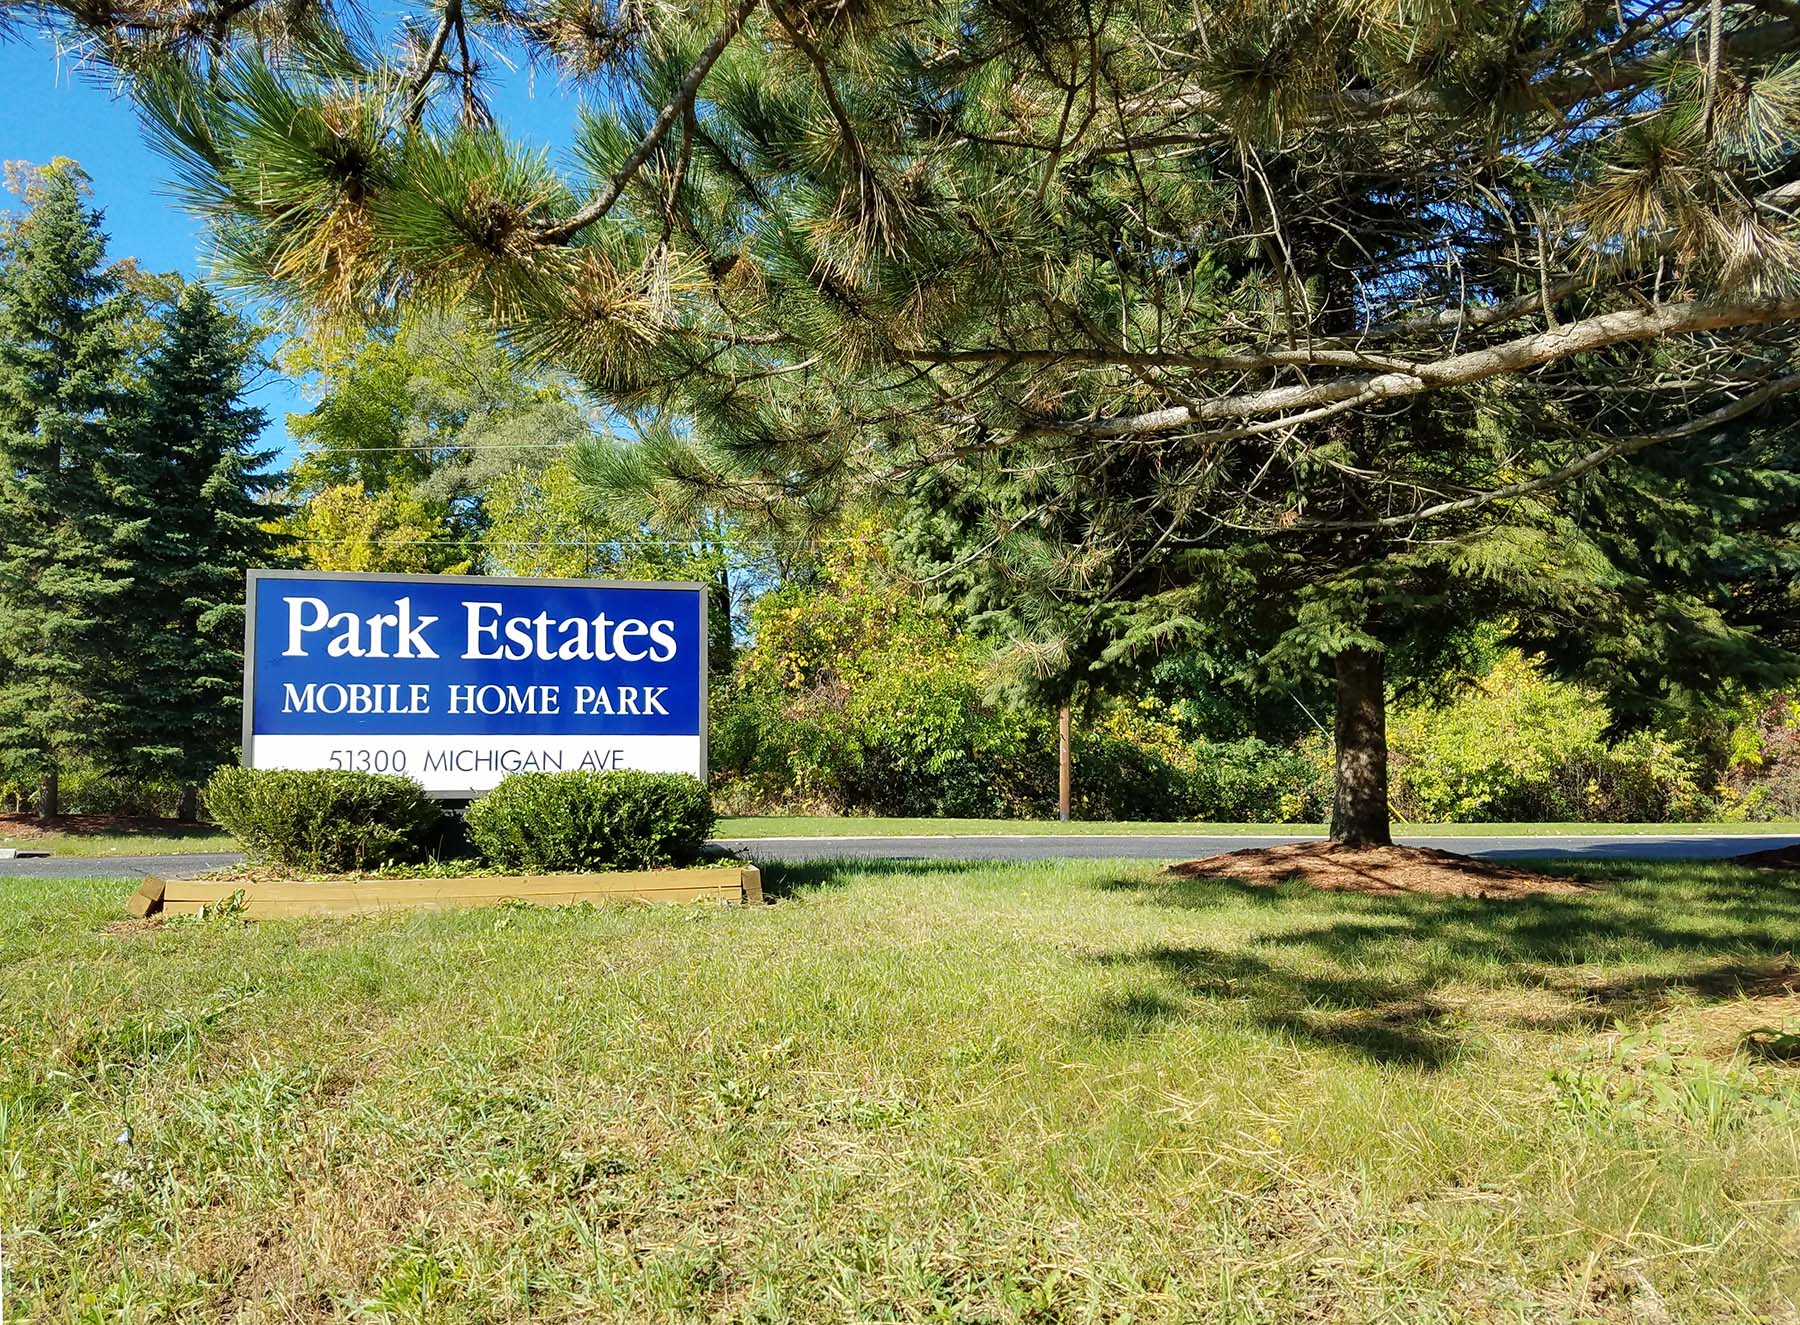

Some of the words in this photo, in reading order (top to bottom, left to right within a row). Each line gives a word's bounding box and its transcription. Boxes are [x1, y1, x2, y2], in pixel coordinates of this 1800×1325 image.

[282, 597, 440, 660] Park
[460, 601, 677, 663] Estates
[281, 683, 430, 714] MOBILE
[447, 684, 560, 715] HOME
[574, 686, 670, 715] PARK
[329, 750, 407, 772] 51300
[423, 750, 563, 772] MICHIGAN
